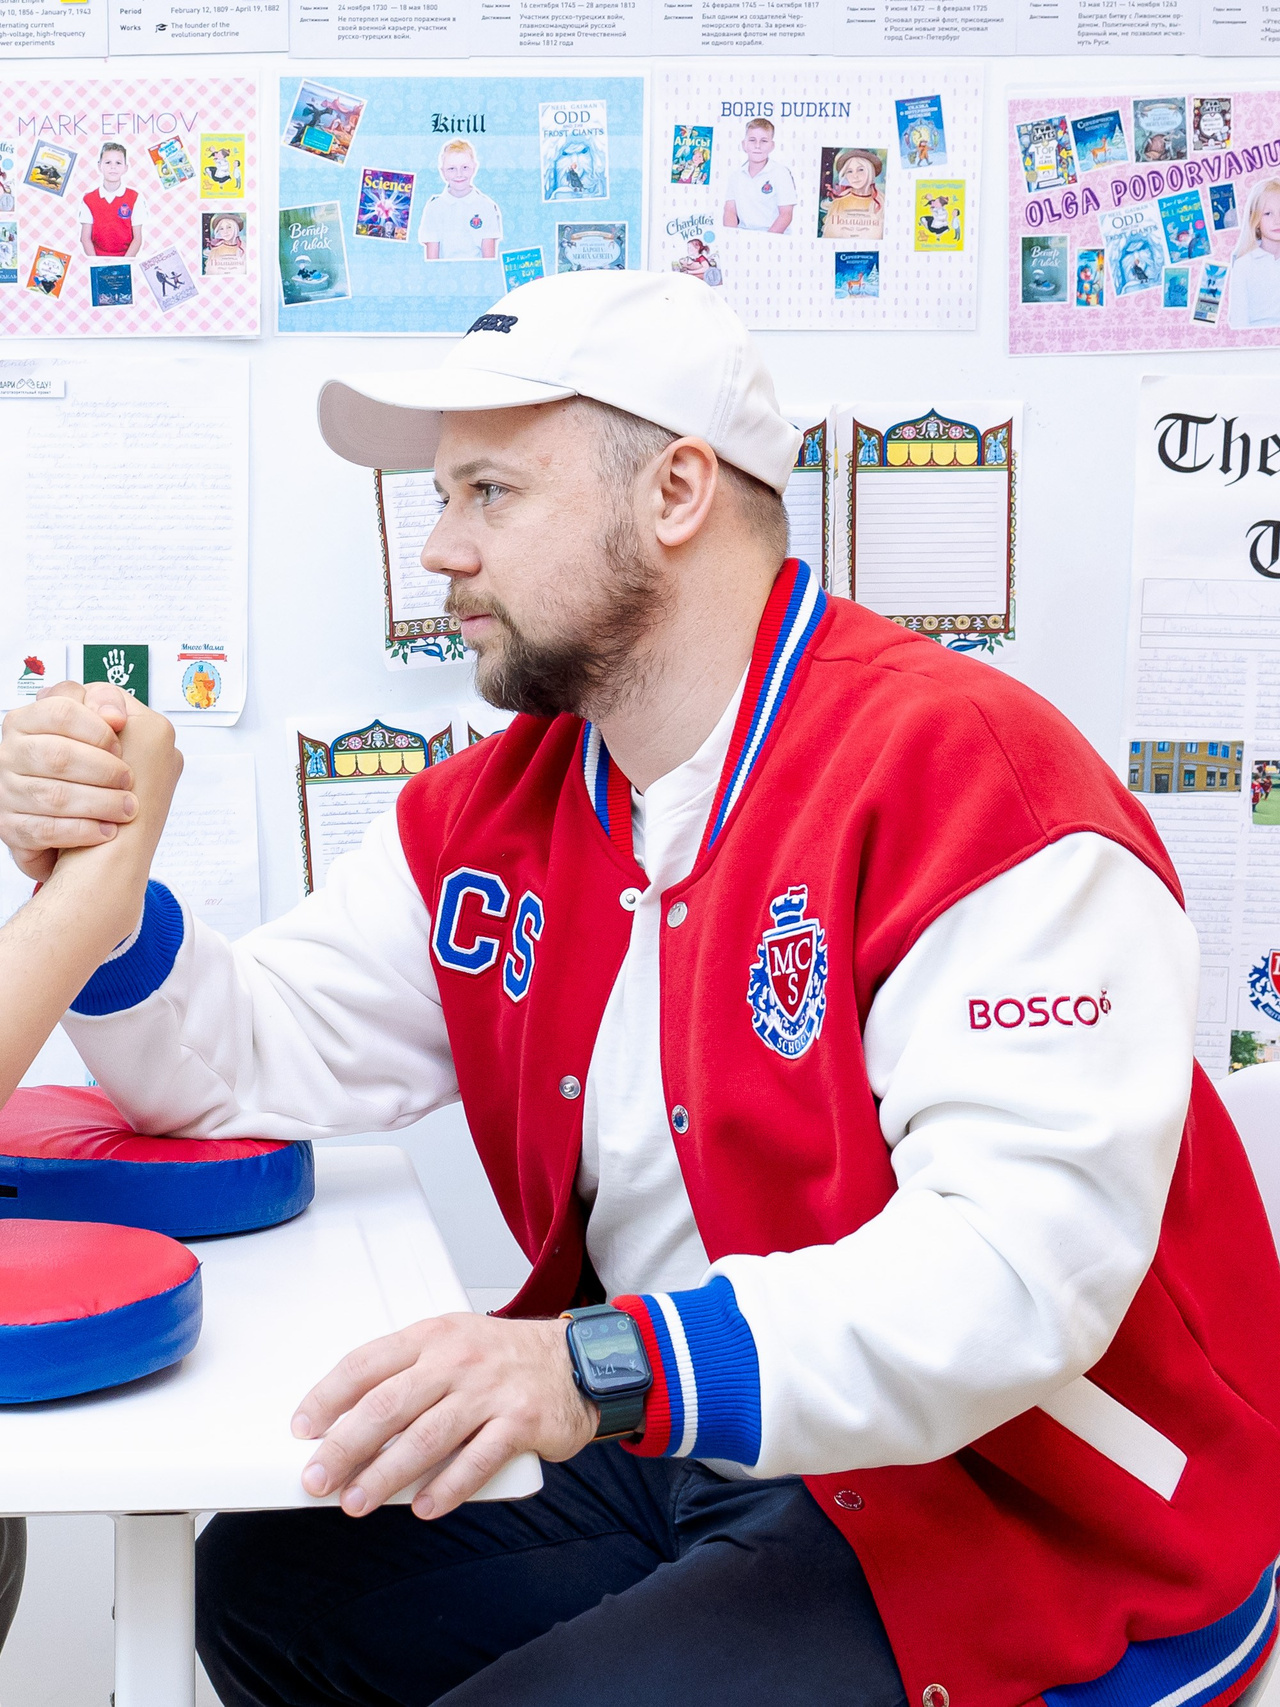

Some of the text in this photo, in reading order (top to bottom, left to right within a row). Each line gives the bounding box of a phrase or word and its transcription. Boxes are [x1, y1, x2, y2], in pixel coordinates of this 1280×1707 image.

[170, 7, 201, 15] February
[235, 5, 252, 13] April
[14, 39, 55, 47] experiments
[36, 30, 86, 39] high-frequency
[171, 31, 211, 39] evolutionary
[551, 103, 598, 111] NEIL GAIMAN
[721, 101, 851, 118] BORIS DUDKIN
[18, 112, 198, 136] MARK EFIMOV
[431, 113, 487, 134] Kirill
[554, 110, 590, 125] ODD
[543, 128, 604, 138] FROST GIANTS
[364, 176, 412, 193] Science
[1025, 187, 1100, 227] OLGA
[666, 215, 714, 235] Charlotte's
[1111, 212, 1144, 229] ODD
[288, 222, 328, 239] Ветер
[680, 226, 703, 241] Web
[36, 381, 51, 389] ЕДУ!
[1154, 412, 1280, 487] The
[969, 995, 1100, 1030] BOSCO
[777, 1030, 811, 1053] SCHOOL
